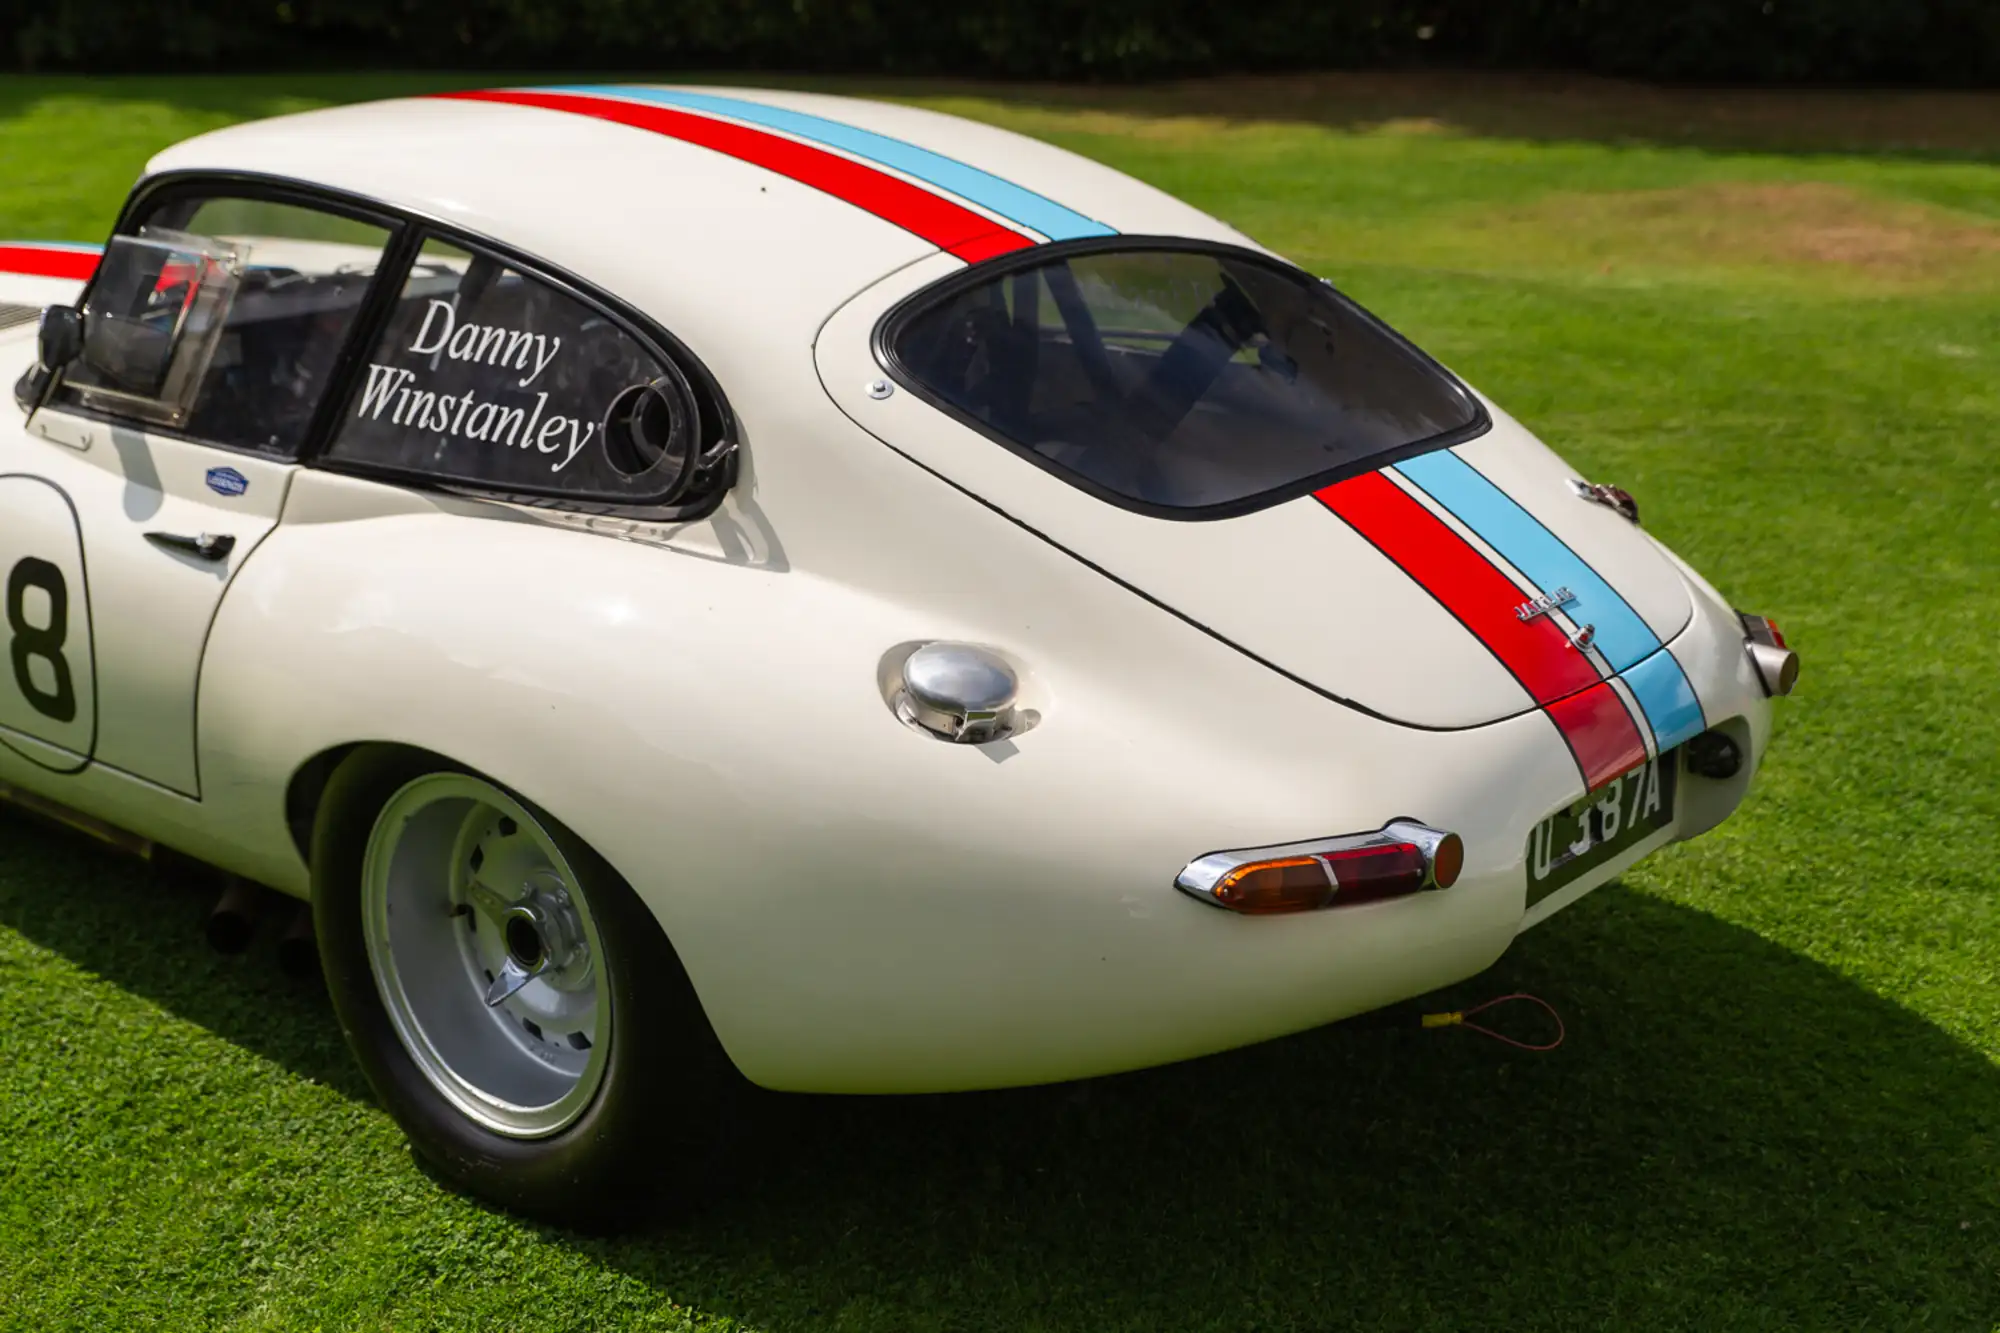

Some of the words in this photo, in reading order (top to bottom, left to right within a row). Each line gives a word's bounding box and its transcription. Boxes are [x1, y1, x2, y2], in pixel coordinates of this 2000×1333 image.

[409, 299, 560, 387] Danny
[357, 363, 594, 472] Winstanley
[6, 556, 76, 723] 8
